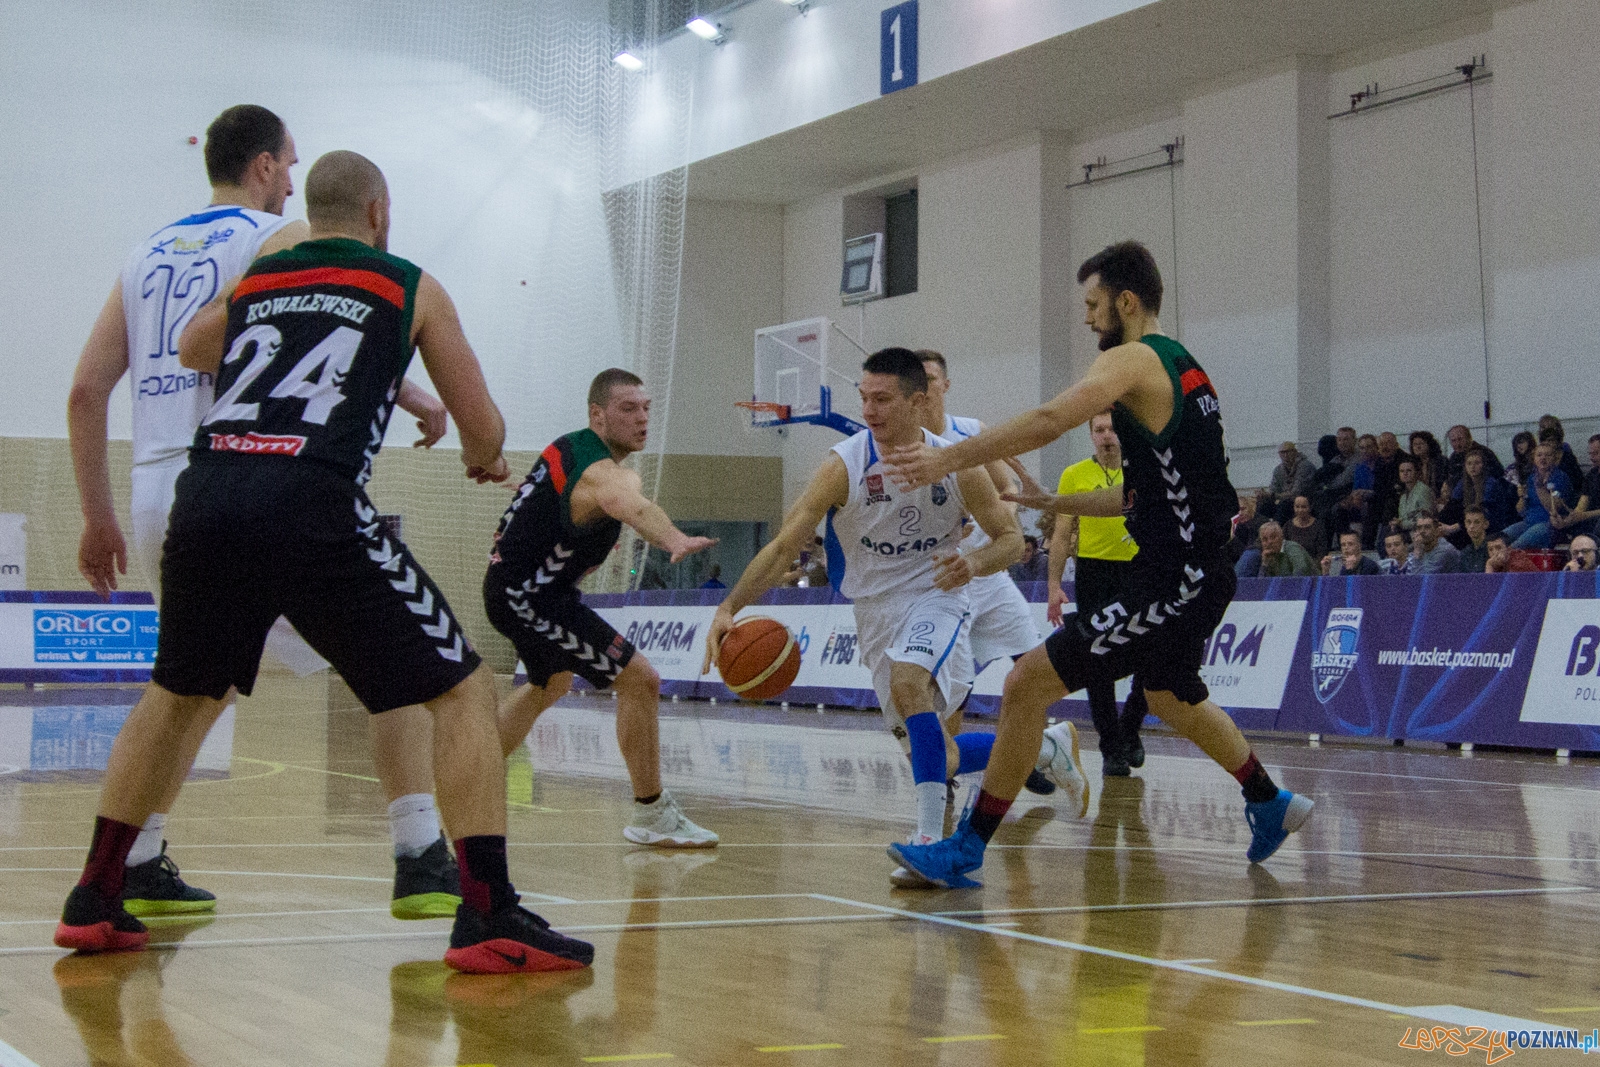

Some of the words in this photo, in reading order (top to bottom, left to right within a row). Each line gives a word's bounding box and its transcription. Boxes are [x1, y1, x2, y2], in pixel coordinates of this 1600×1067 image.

[890, 13, 903, 81] 1
[142, 257, 219, 358] 12
[245, 293, 373, 324] KOWALEWSKI
[201, 323, 365, 426] 24
[900, 505, 921, 536] 2
[860, 533, 950, 555] BIOFAR
[1090, 601, 1128, 632] 5
[64, 637, 105, 646] SPORT
[625, 620, 698, 652] BIOFARM
[908, 621, 935, 645] 2
[1312, 653, 1359, 669] BASKET
[1377, 646, 1516, 672] www.basket.poznan.pl
